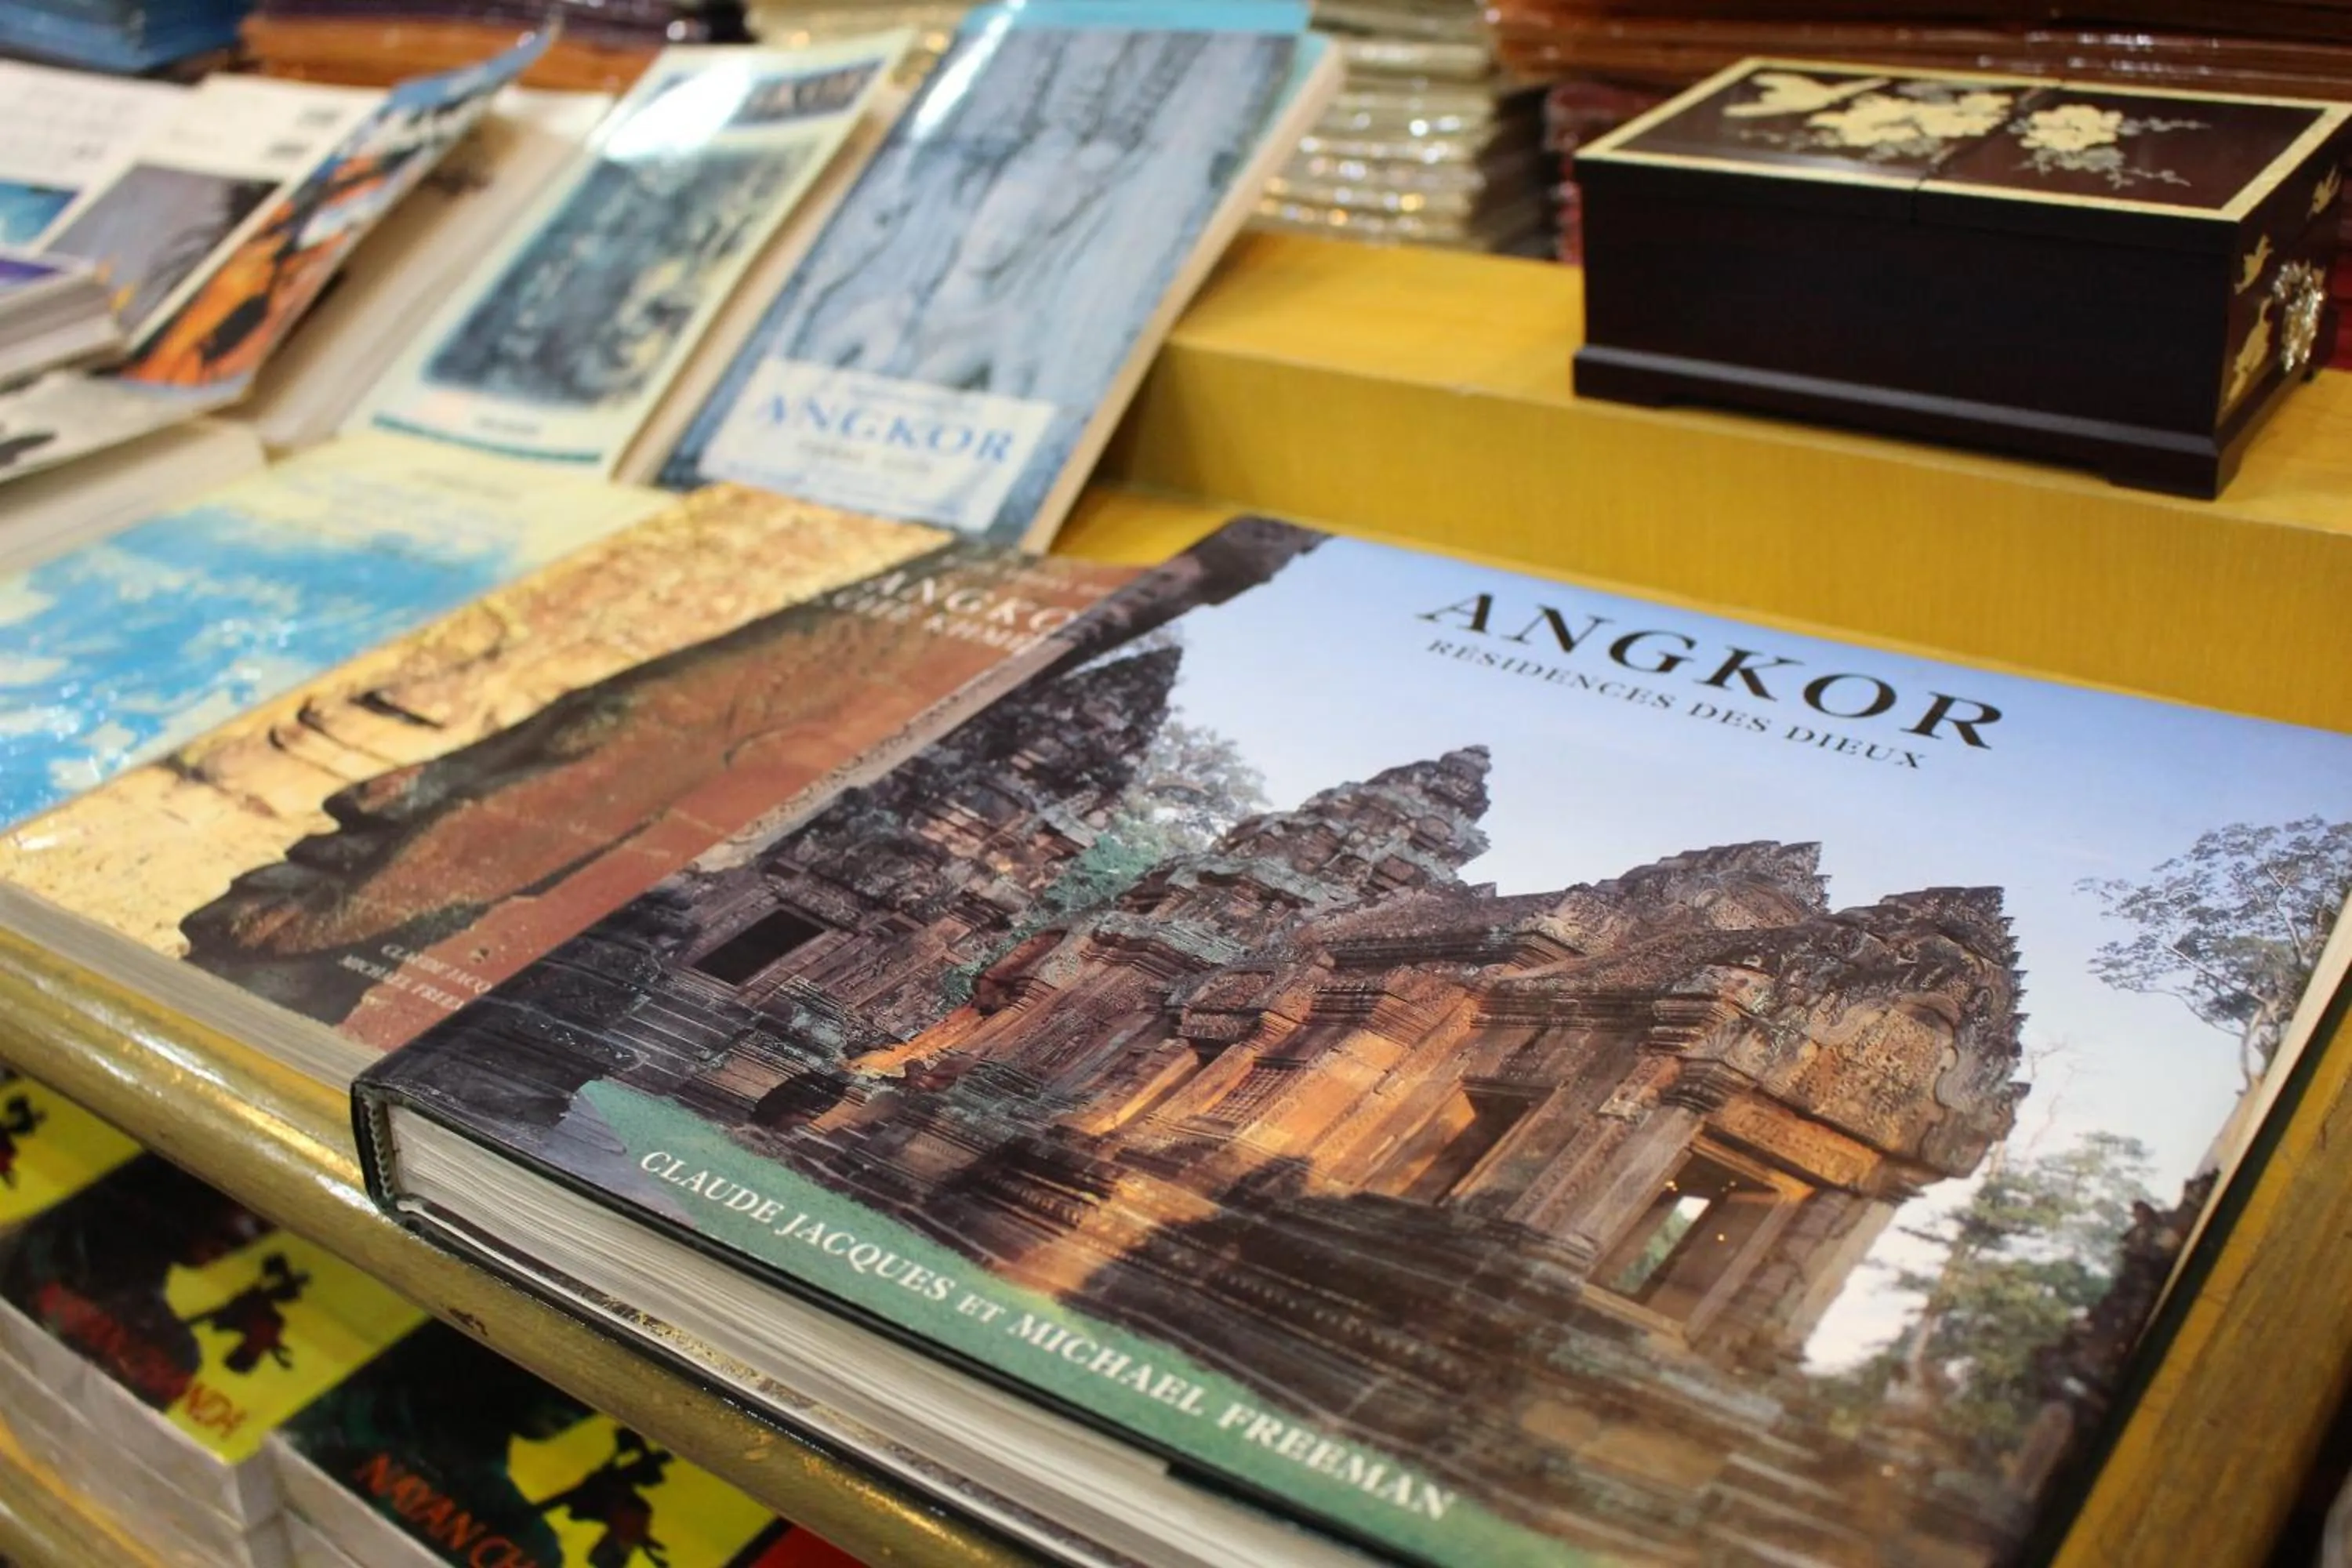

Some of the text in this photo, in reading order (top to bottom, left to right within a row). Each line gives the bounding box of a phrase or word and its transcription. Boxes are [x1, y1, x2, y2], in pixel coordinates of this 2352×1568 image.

[757, 394, 1014, 463] ANGKOR
[1416, 592, 2002, 750] ANGKOR
[1687, 702, 1773, 733] DES
[1784, 725, 1928, 770] DIEUX
[639, 1150, 1457, 1521] CLAUDE JACQUES ET MICHAEL FREEMAN
